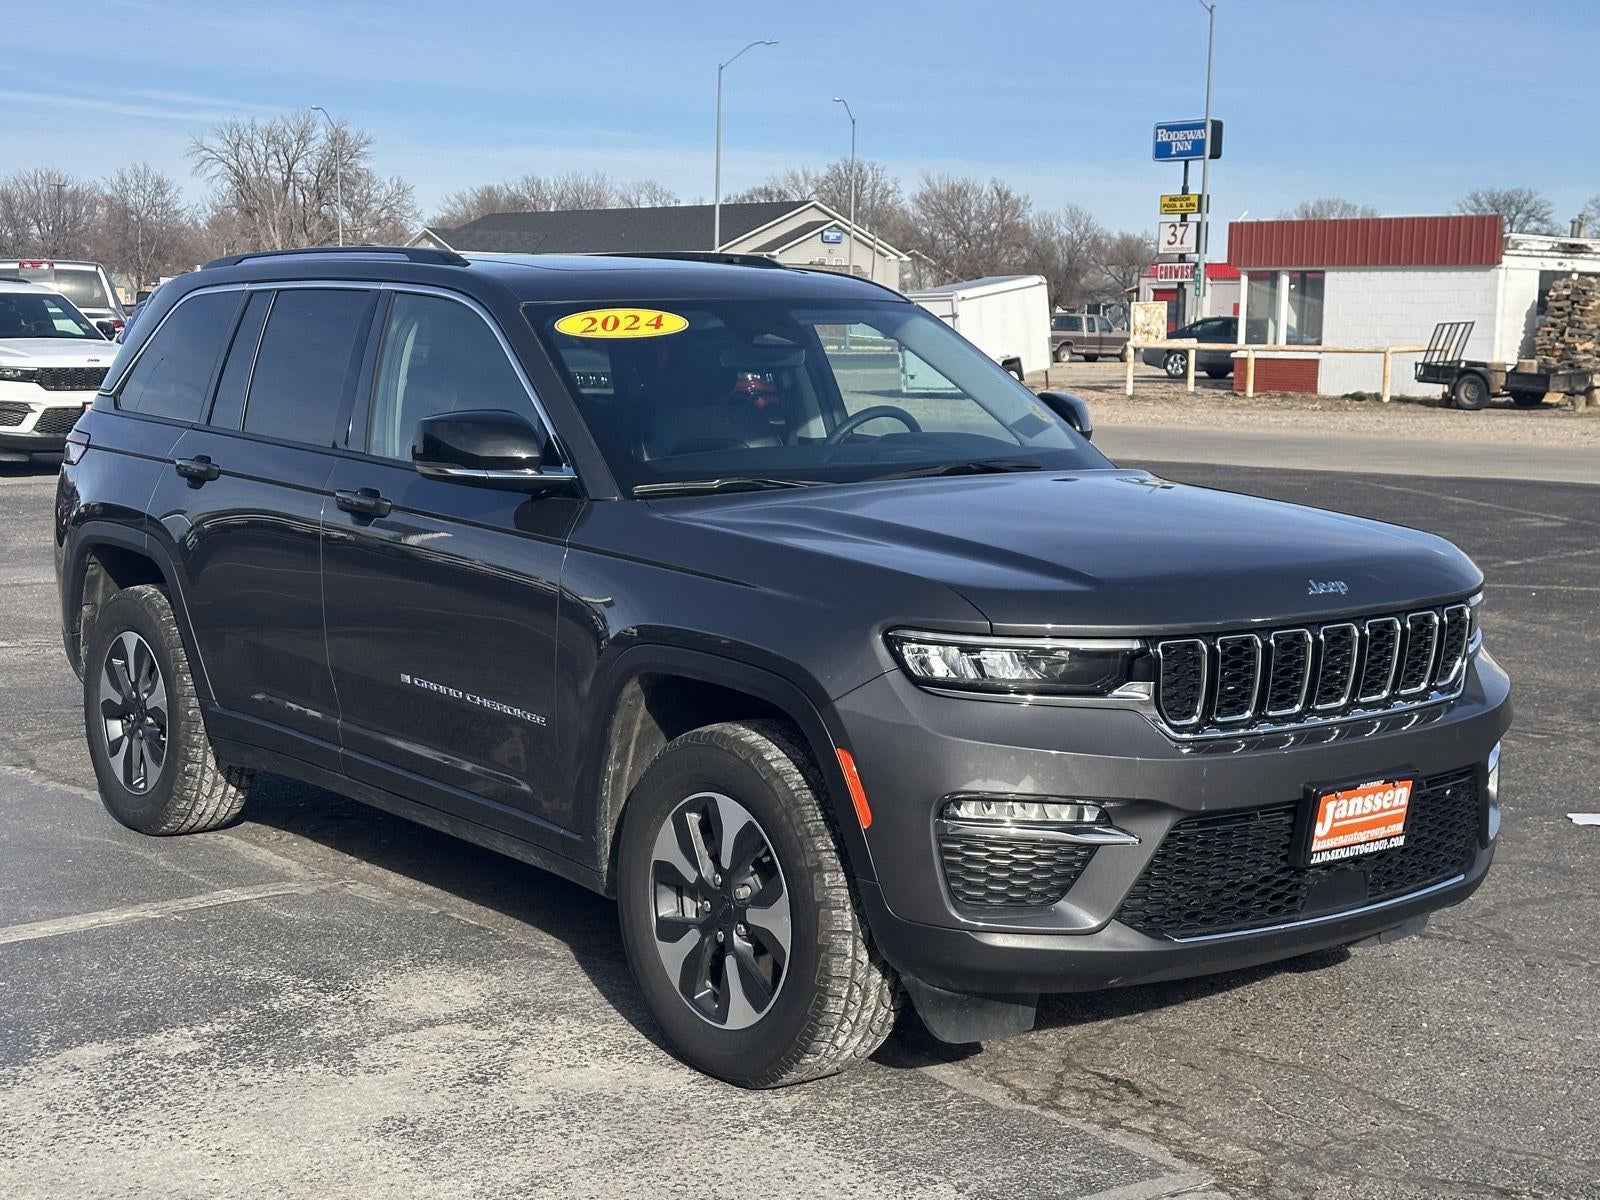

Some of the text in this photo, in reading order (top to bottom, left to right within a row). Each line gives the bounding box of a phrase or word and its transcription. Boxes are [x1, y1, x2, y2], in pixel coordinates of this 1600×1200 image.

[1171, 141, 1192, 154] INN
[1167, 223, 1189, 245] 37
[580, 313, 664, 333] 2024
[1307, 579, 1349, 595] Jeep
[413, 677, 547, 727] GRAND CHEROKEE
[1315, 787, 1408, 837] Janssen
